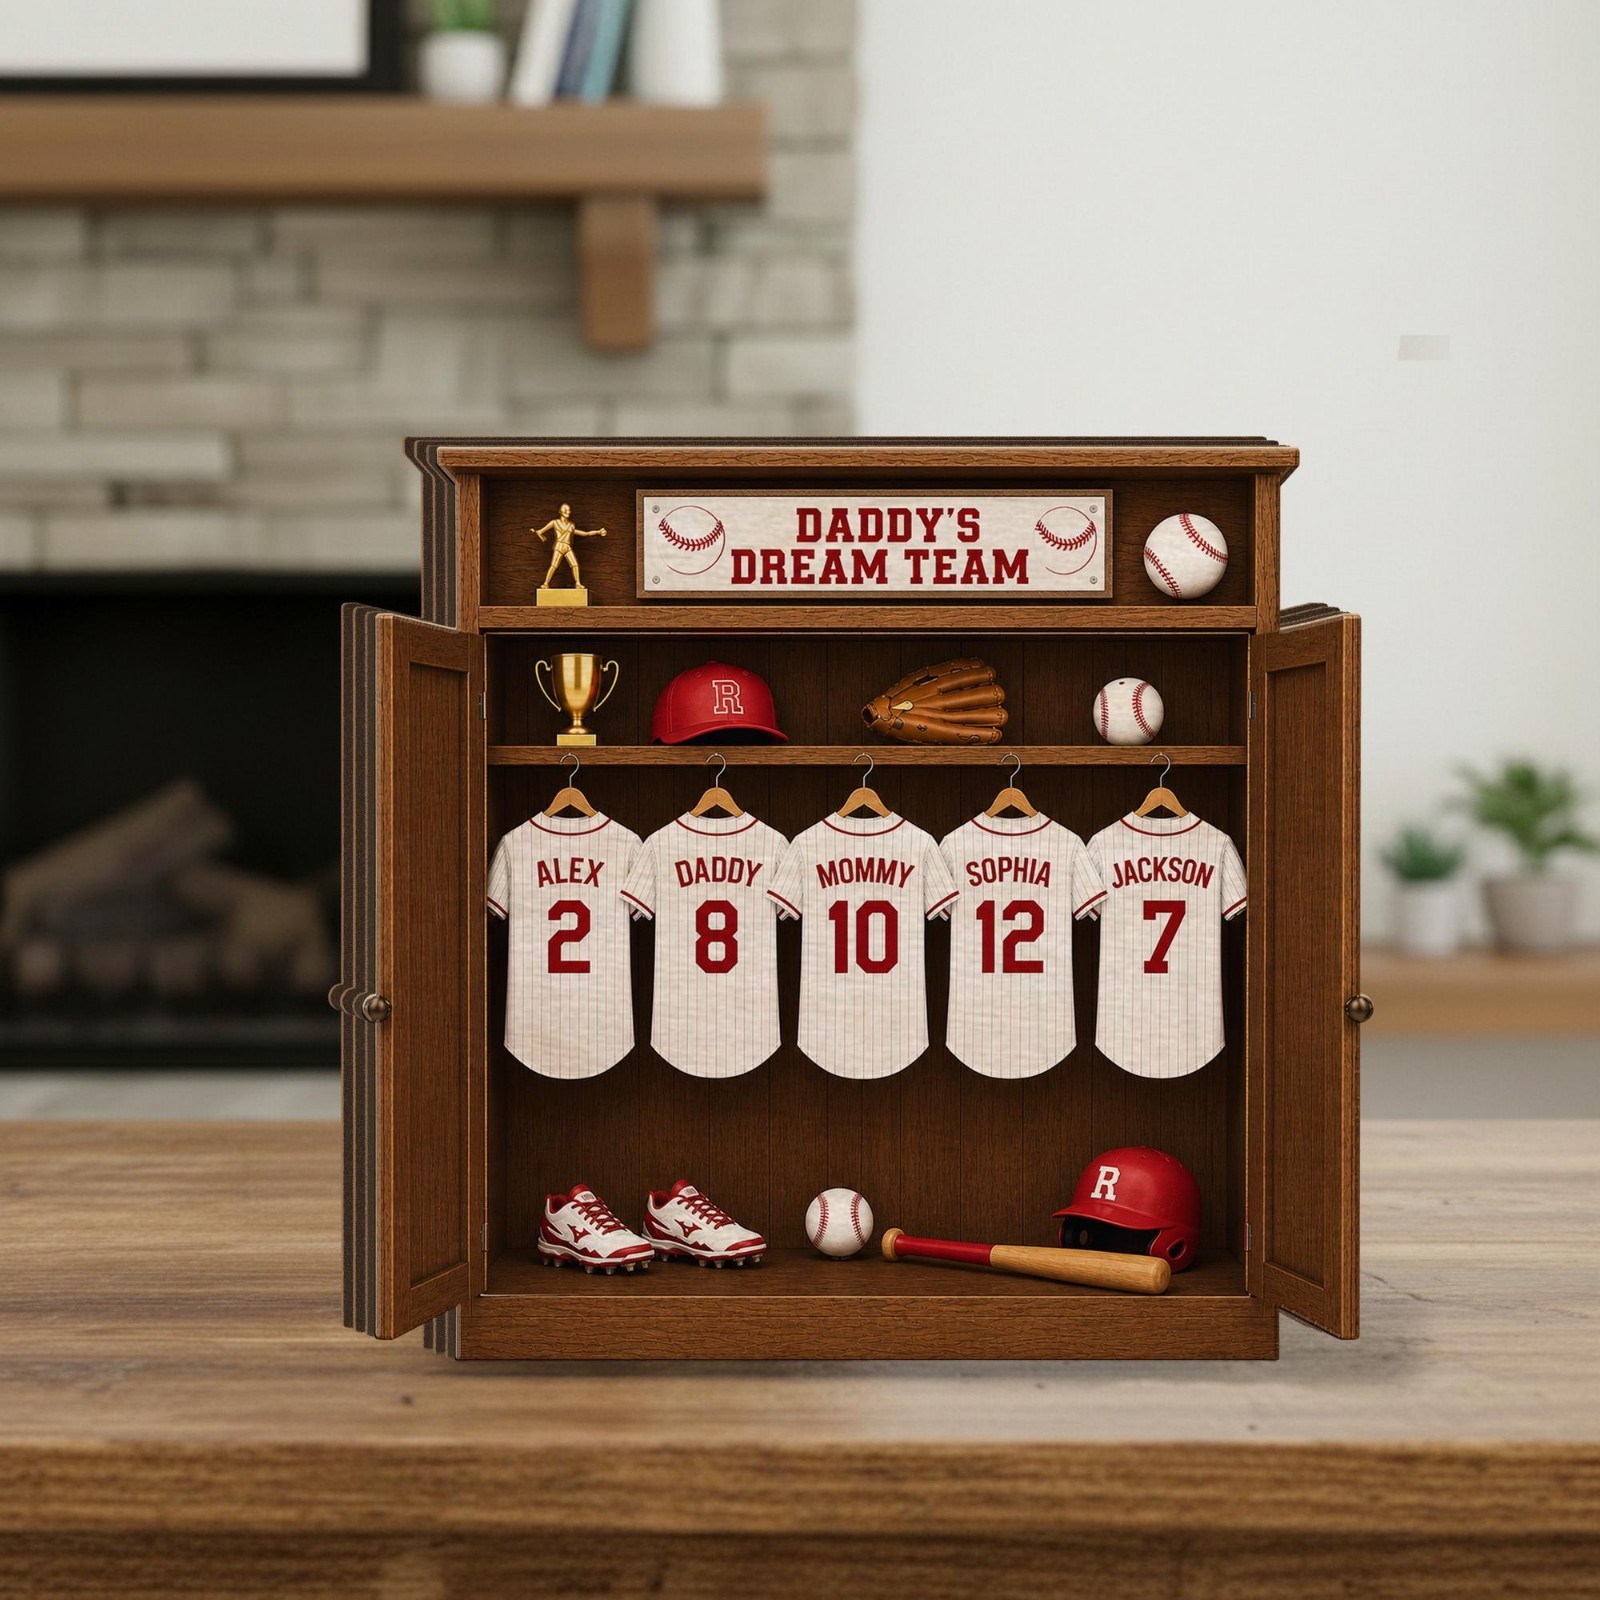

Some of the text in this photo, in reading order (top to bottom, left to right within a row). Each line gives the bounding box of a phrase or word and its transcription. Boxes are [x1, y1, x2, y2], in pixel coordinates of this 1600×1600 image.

[796, 507, 980, 543] DADDY'S
[731, 548, 1029, 585] DREAM TEAM
[711, 679, 744, 715] R
[536, 856, 605, 888] ALEX
[675, 856, 763, 888] DADDY
[816, 857, 915, 889] MOMMY
[966, 856, 1051, 889] SOPHIA
[1112, 856, 1215, 889] JACKSON
[547, 899, 591, 974] 2
[695, 899, 739, 974] 8
[828, 899, 899, 974] 10
[975, 899, 1045, 974] 12
[1142, 899, 1187, 974] 7
[1090, 1165, 1121, 1202] R
